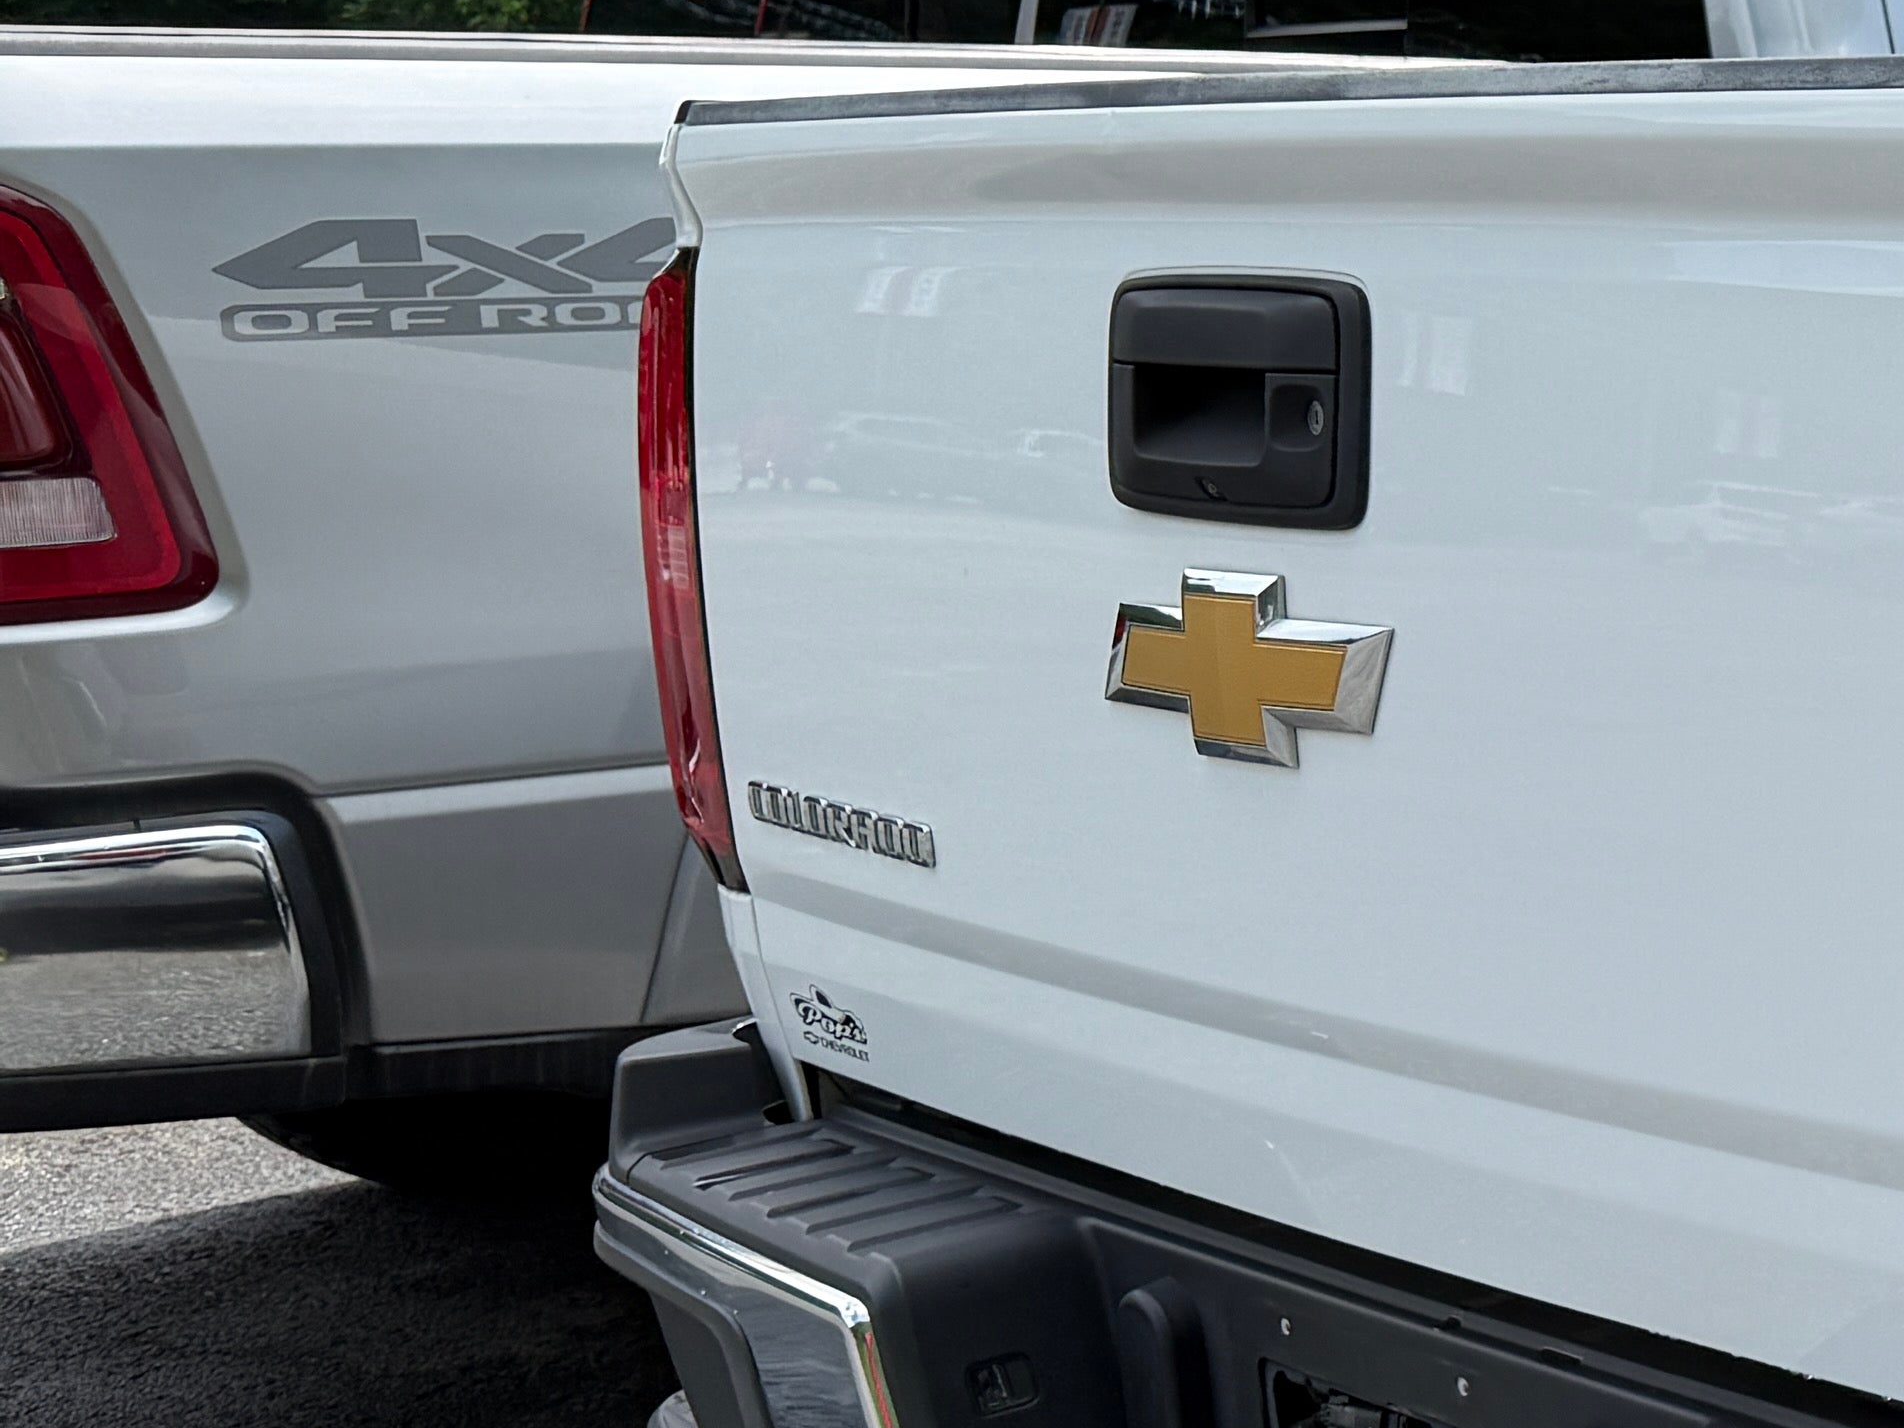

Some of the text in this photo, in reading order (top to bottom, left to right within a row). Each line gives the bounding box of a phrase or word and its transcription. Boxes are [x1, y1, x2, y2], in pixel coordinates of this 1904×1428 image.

[233, 301, 643, 336] OFF RO
[748, 780, 937, 868] COLORADO
